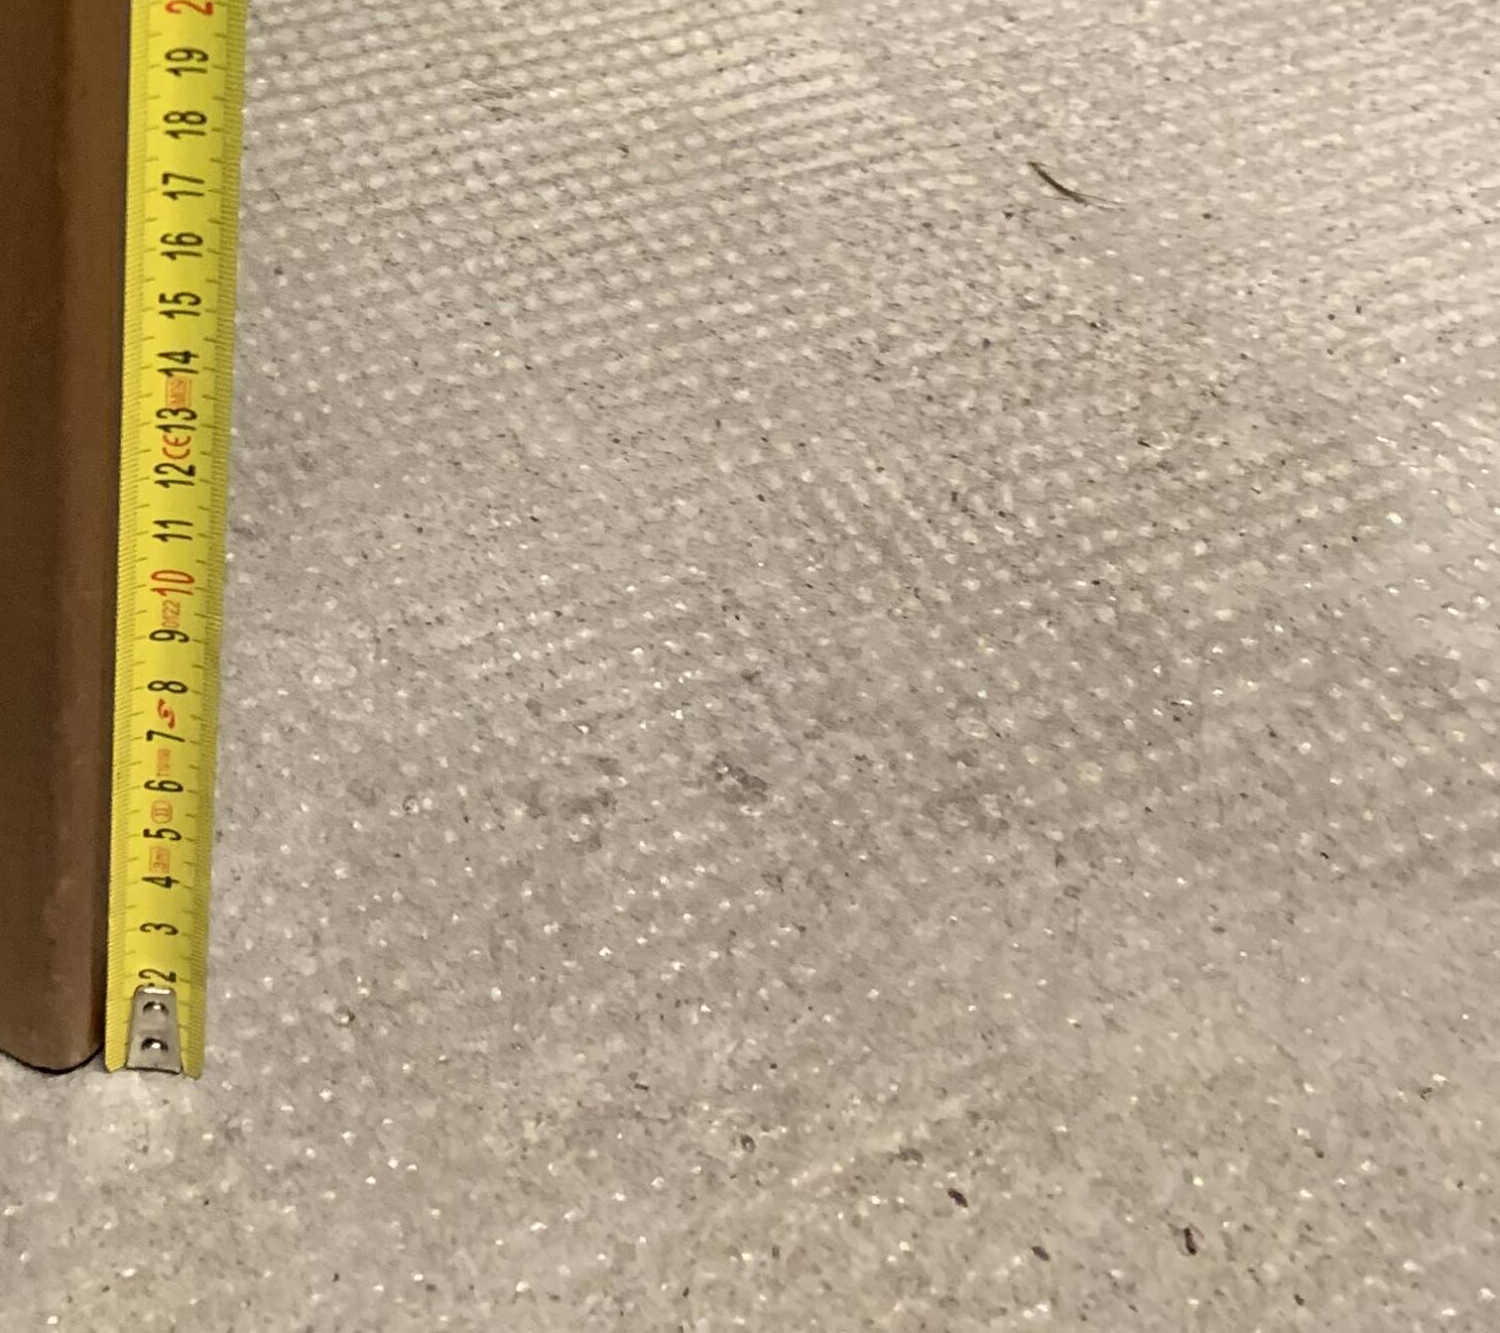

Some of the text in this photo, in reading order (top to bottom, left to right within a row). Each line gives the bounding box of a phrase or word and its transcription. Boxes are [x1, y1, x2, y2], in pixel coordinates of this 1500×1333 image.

[164, 47, 210, 78] 19
[162, 110, 208, 140] 18
[161, 172, 205, 201] 17
[159, 232, 204, 261] 16
[158, 291, 203, 320] 15
[157, 349, 200, 379] 14
[155, 406, 199, 434] 13
[153, 462, 197, 489] 12
[152, 519, 194, 543] 11
[150, 569, 196, 597] 10
[148, 628, 191, 644] 9
[147, 680, 190, 695] 8
[145, 729, 186, 743] 7
[143, 779, 185, 793] 6
[142, 827, 183, 842] 5
[141, 875, 181, 890] 4
[139, 922, 180, 936] 3
[138, 968, 177, 984] 2
